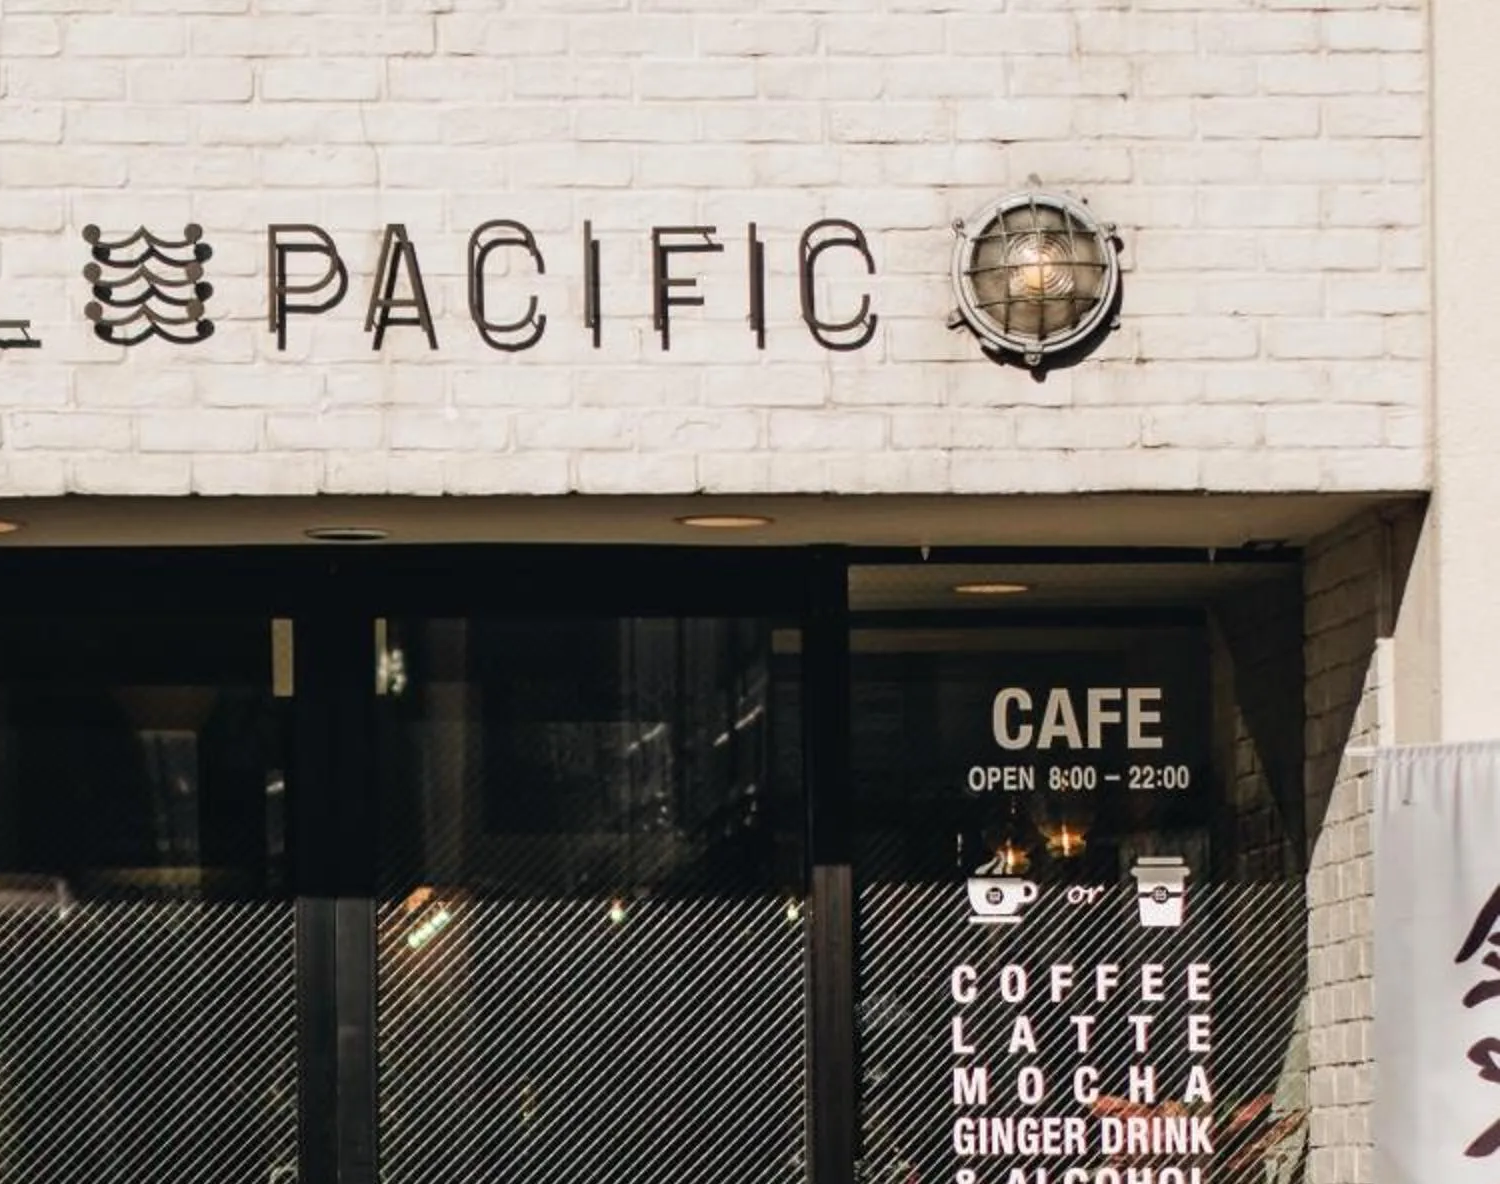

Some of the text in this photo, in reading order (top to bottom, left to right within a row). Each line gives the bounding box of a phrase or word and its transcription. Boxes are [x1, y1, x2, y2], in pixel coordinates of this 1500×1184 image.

[267, 218, 874, 344] PACIFIC
[992, 687, 1164, 750] CAFE
[968, 766, 1035, 791] OPEN
[1049, 766, 1096, 791] 8:00
[1128, 765, 1190, 790] 22:00
[1067, 885, 1104, 904] or
[950, 963, 1212, 1003] COFFEE
[951, 1015, 1212, 1053] LATTE
[952, 1065, 1213, 1105] MOCHA
[953, 1116, 1214, 1155] GINGER DRINK
